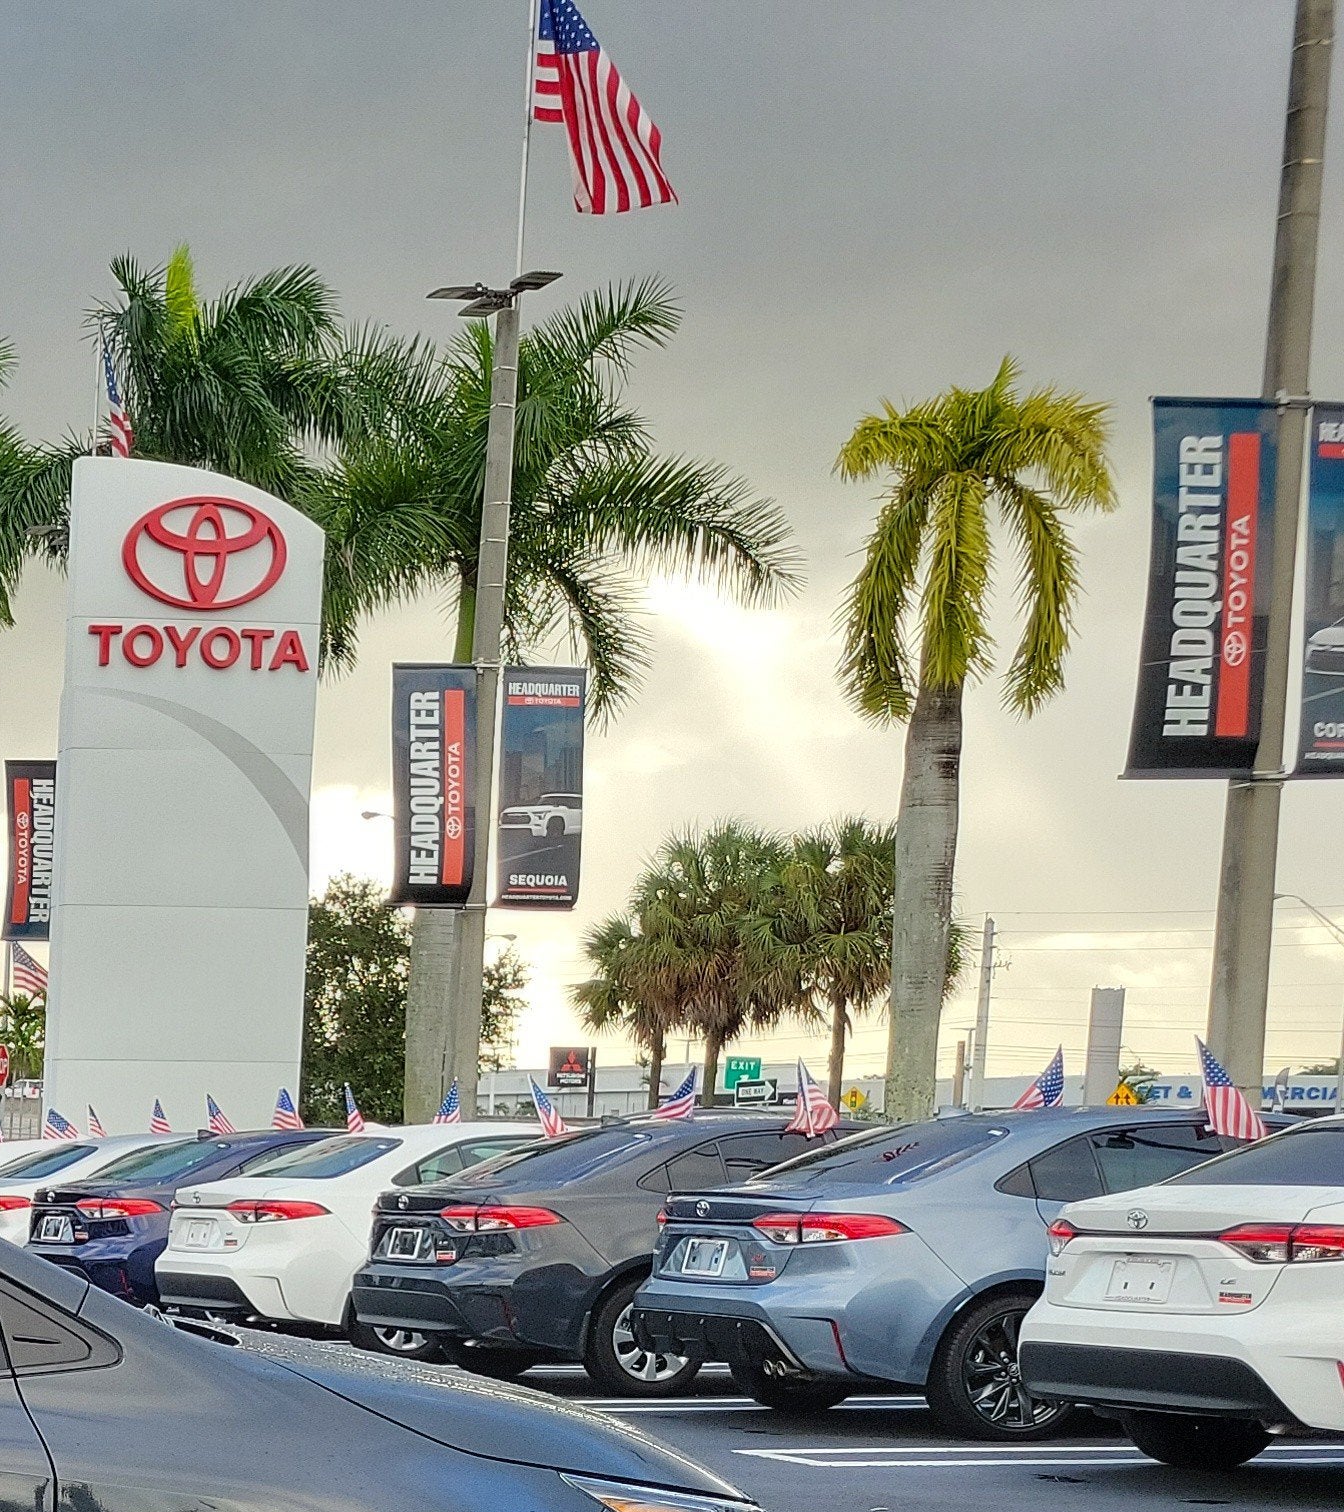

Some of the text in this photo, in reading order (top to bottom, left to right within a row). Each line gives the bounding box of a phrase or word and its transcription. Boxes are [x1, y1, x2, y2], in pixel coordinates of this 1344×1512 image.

[1162, 435, 1224, 736] HEADQUARTER
[1227, 514, 1251, 629] TOYOTA
[88, 624, 310, 673] TOYOTA
[508, 682, 580, 697] HEADQUARTER
[409, 691, 444, 885] HEADQUARTER
[448, 742, 461, 815] TOYOTA
[17, 830, 29, 885] TOYOTA
[28, 778, 55, 923] HEADQUARTER
[509, 874, 568, 887] SEQUOIA
[730, 1060, 756, 1070] EXIT
[741, 1088, 752, 1096] ONE
[1177, 1085, 1192, 1099] &
